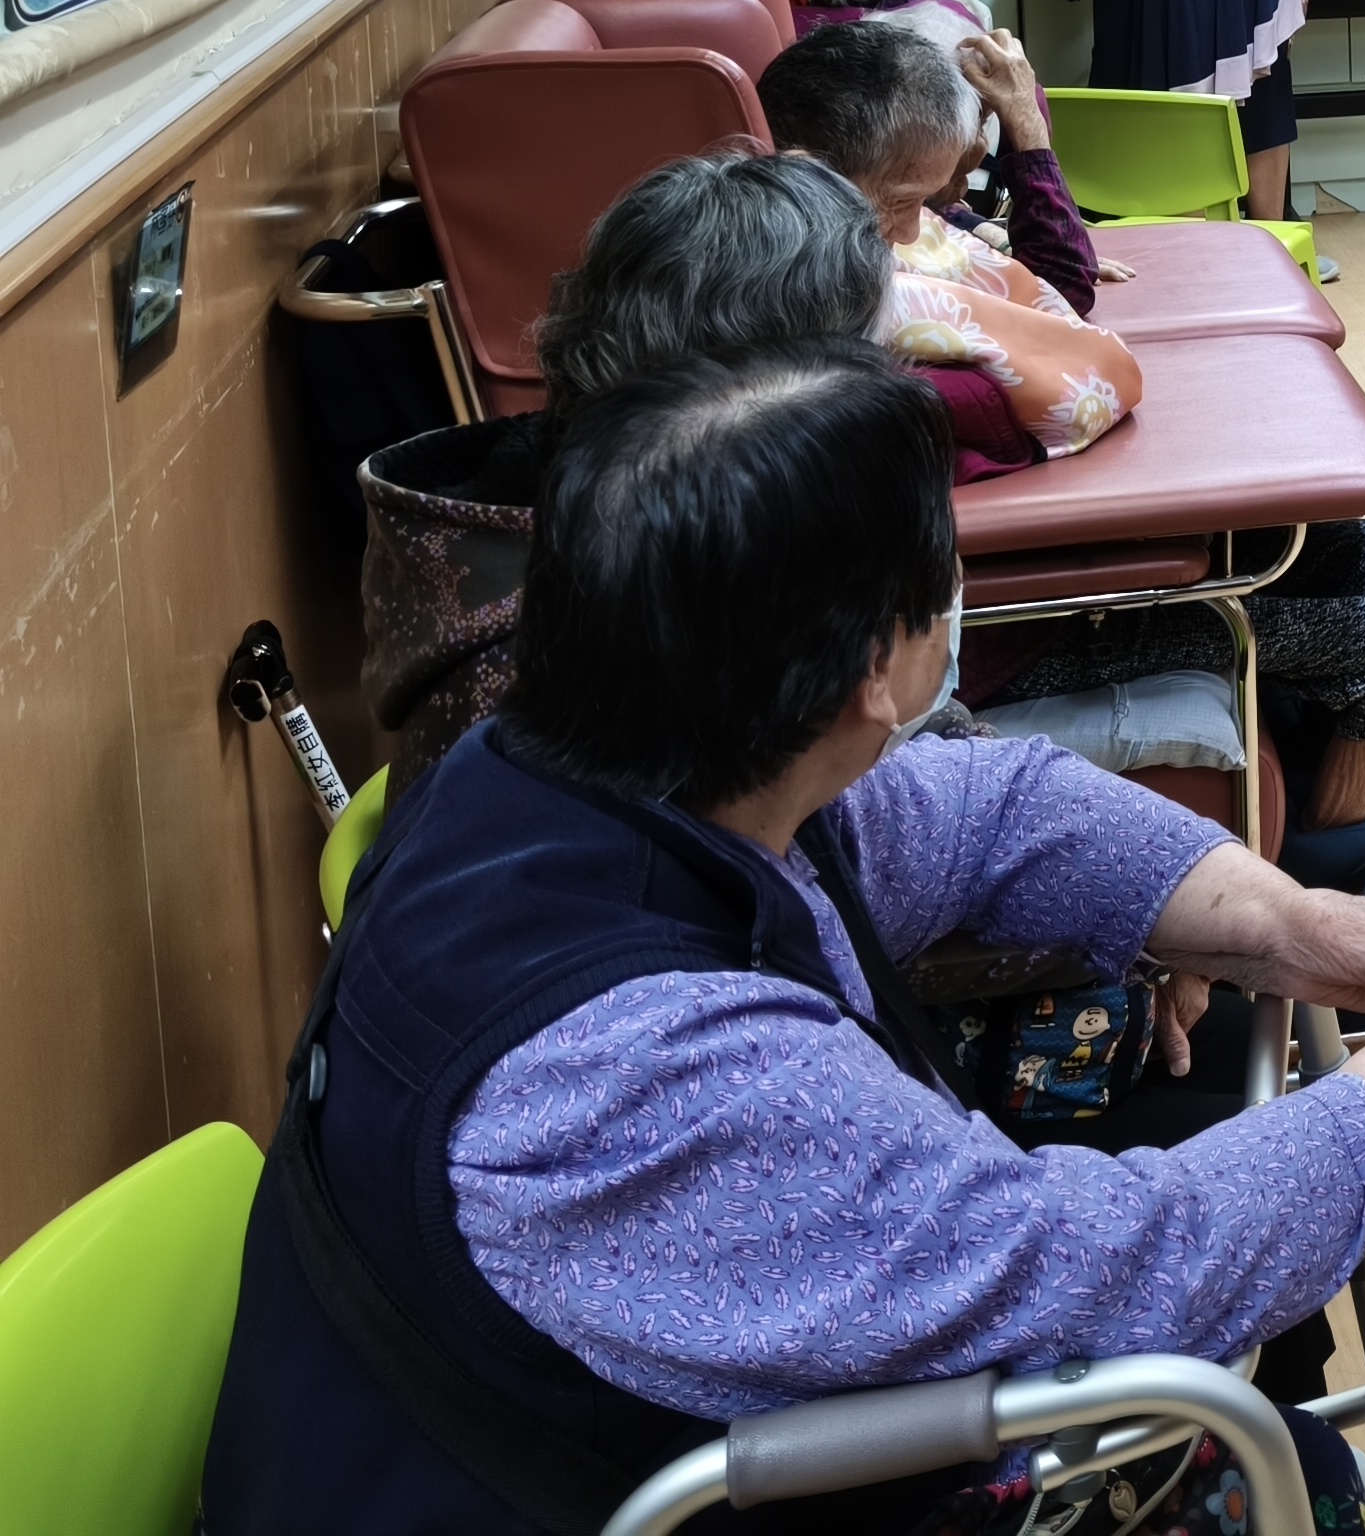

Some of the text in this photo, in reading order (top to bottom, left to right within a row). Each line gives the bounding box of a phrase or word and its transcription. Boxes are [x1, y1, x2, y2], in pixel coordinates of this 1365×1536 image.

[285, 713, 347, 812] 李紅女自購
